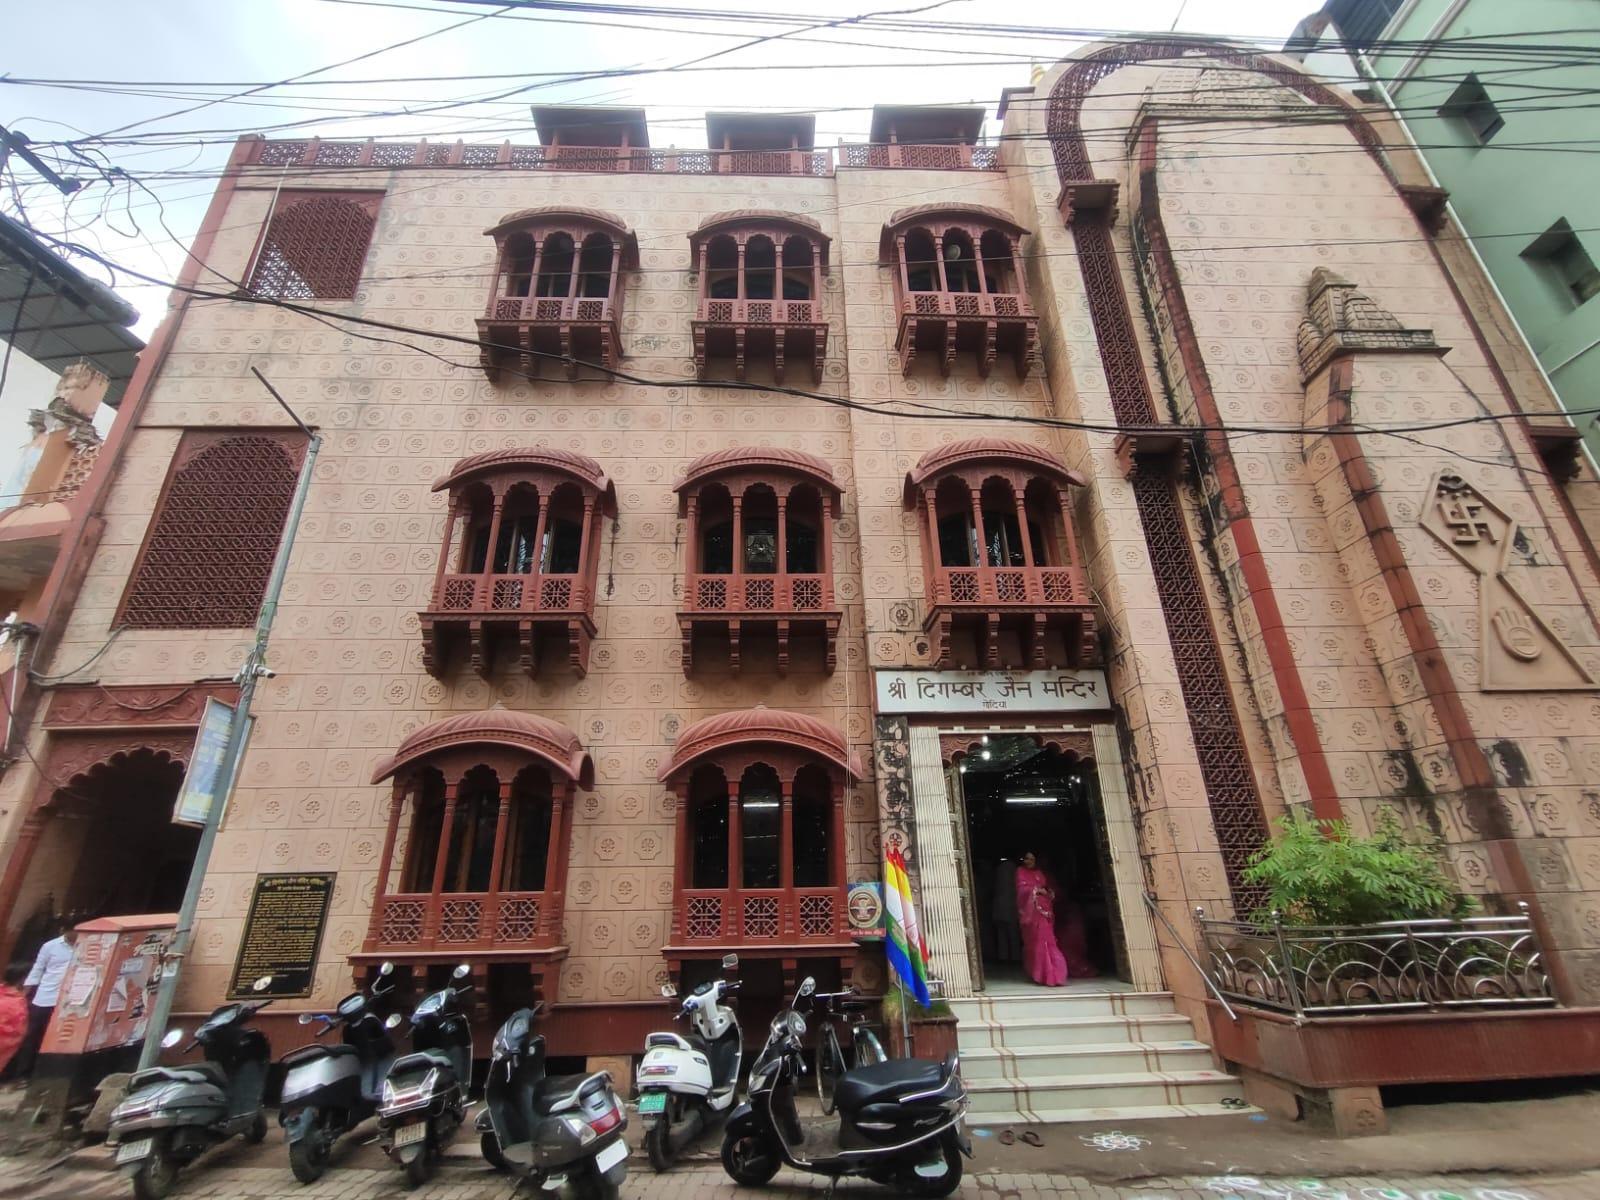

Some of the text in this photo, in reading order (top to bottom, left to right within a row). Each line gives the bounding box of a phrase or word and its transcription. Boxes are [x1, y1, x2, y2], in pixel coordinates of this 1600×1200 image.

[888, 676, 1097, 700] श्री दिगम्बर जैन मन्दिर
